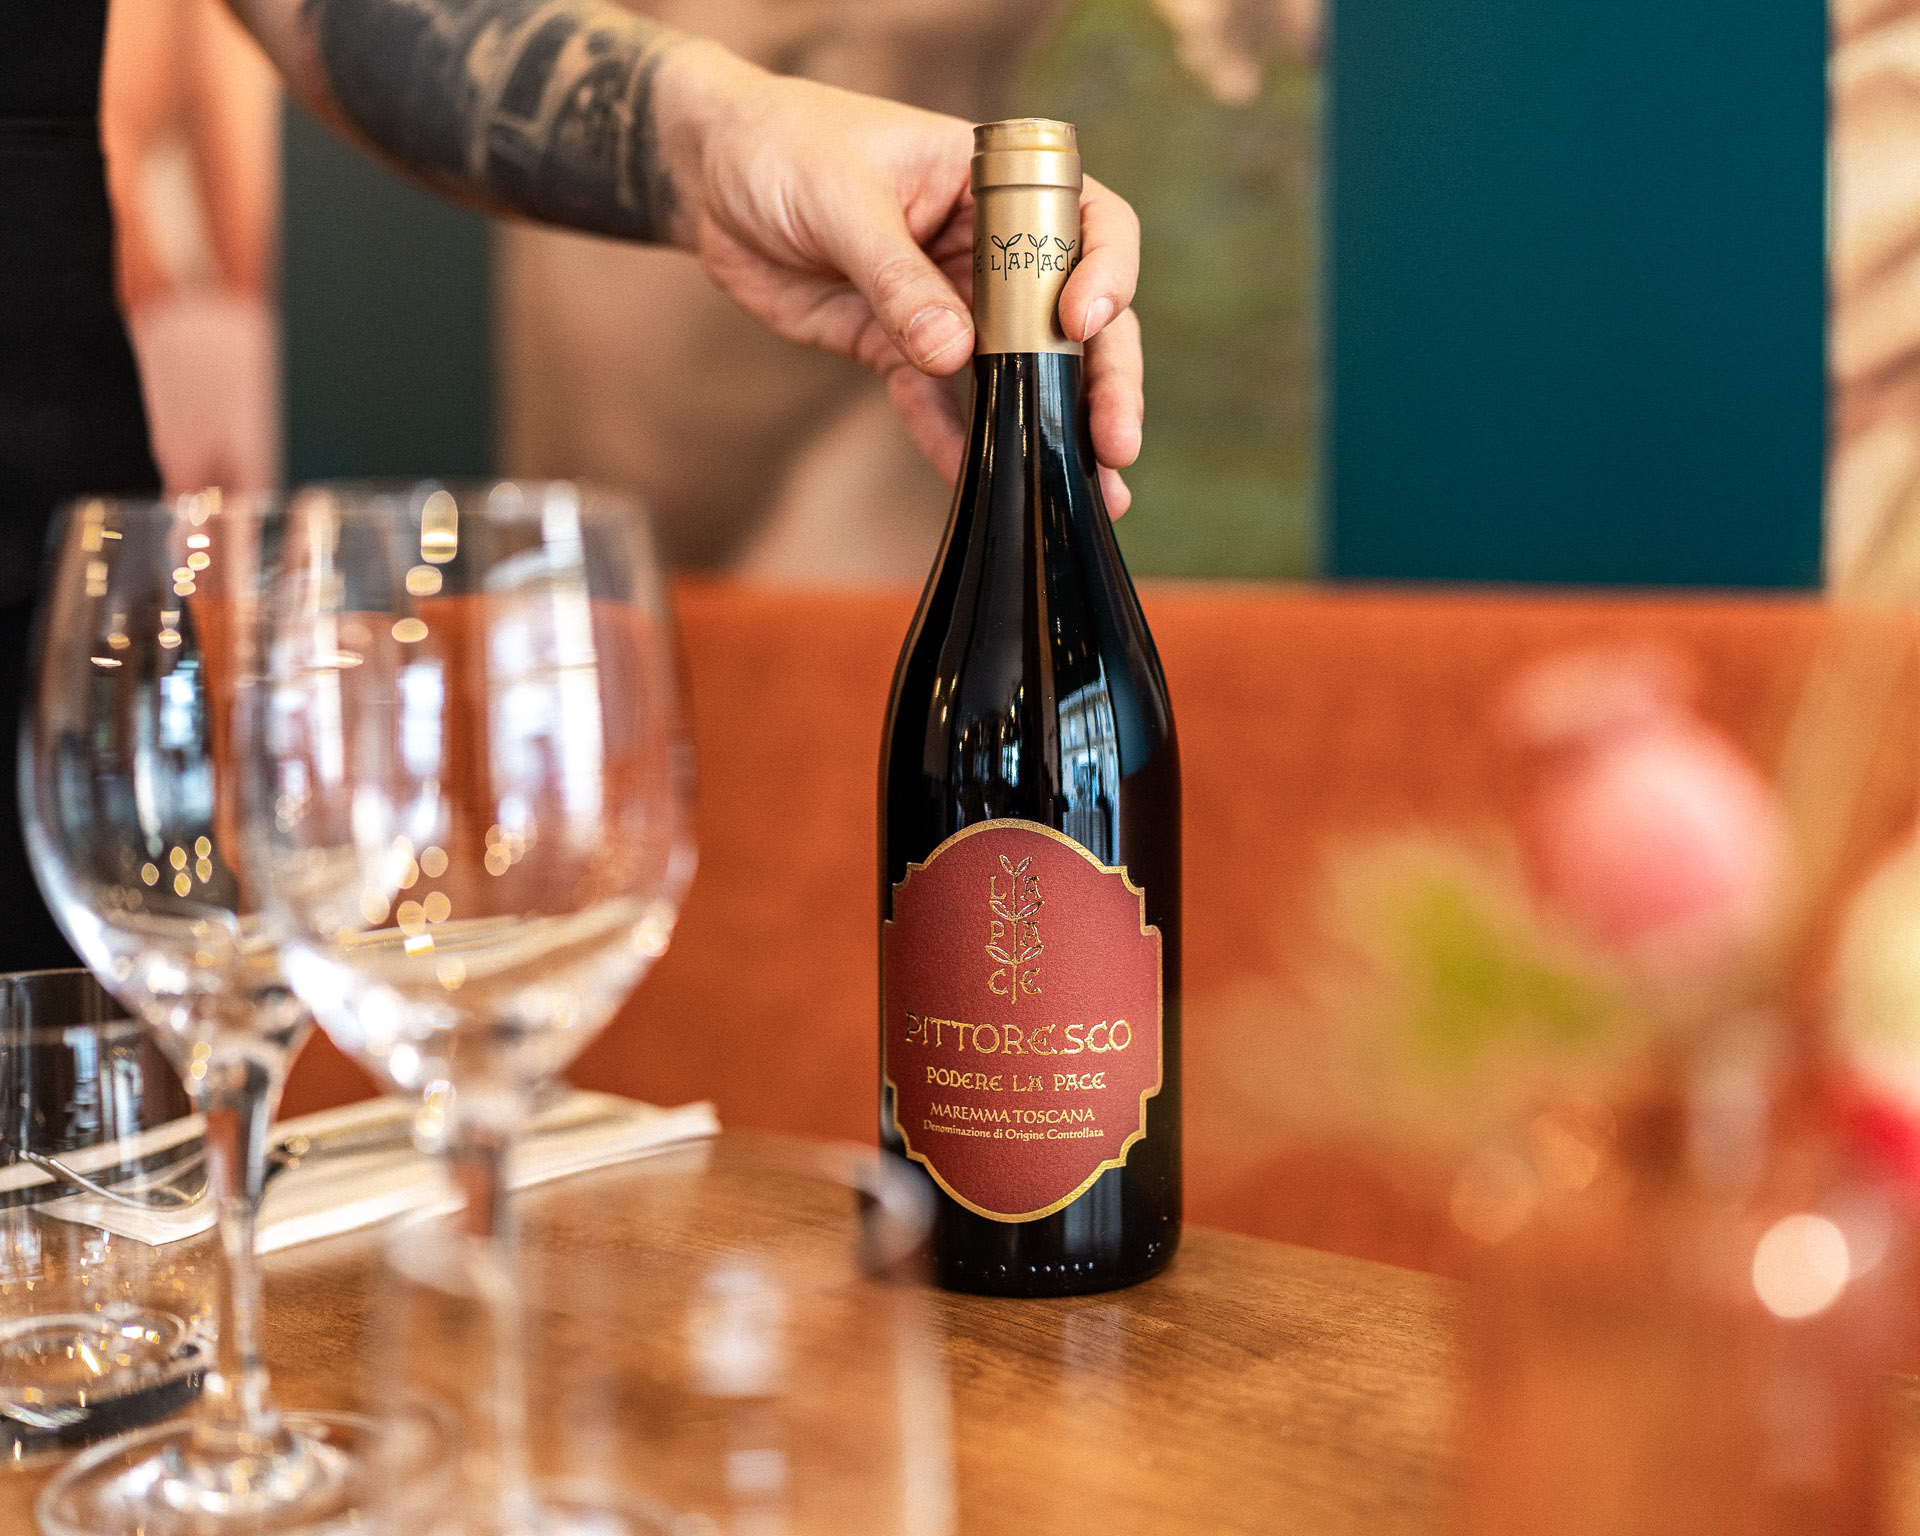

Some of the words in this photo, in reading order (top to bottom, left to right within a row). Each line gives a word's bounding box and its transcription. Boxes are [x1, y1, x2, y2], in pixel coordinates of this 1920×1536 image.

[905, 1011, 1132, 1056] PITTORESCO
[926, 1066, 1004, 1092] PODERE
[1013, 1075, 1043, 1092] LA
[1053, 1072, 1106, 1092] PACE
[930, 1103, 1011, 1124] MAREMMA
[1012, 1108, 1095, 1124] TOSCANA
[923, 1119, 991, 1138] Denominazione
[993, 1128, 1003, 1139] di
[1005, 1128, 1045, 1142] Origine
[1046, 1127, 1104, 1140] Controllata
